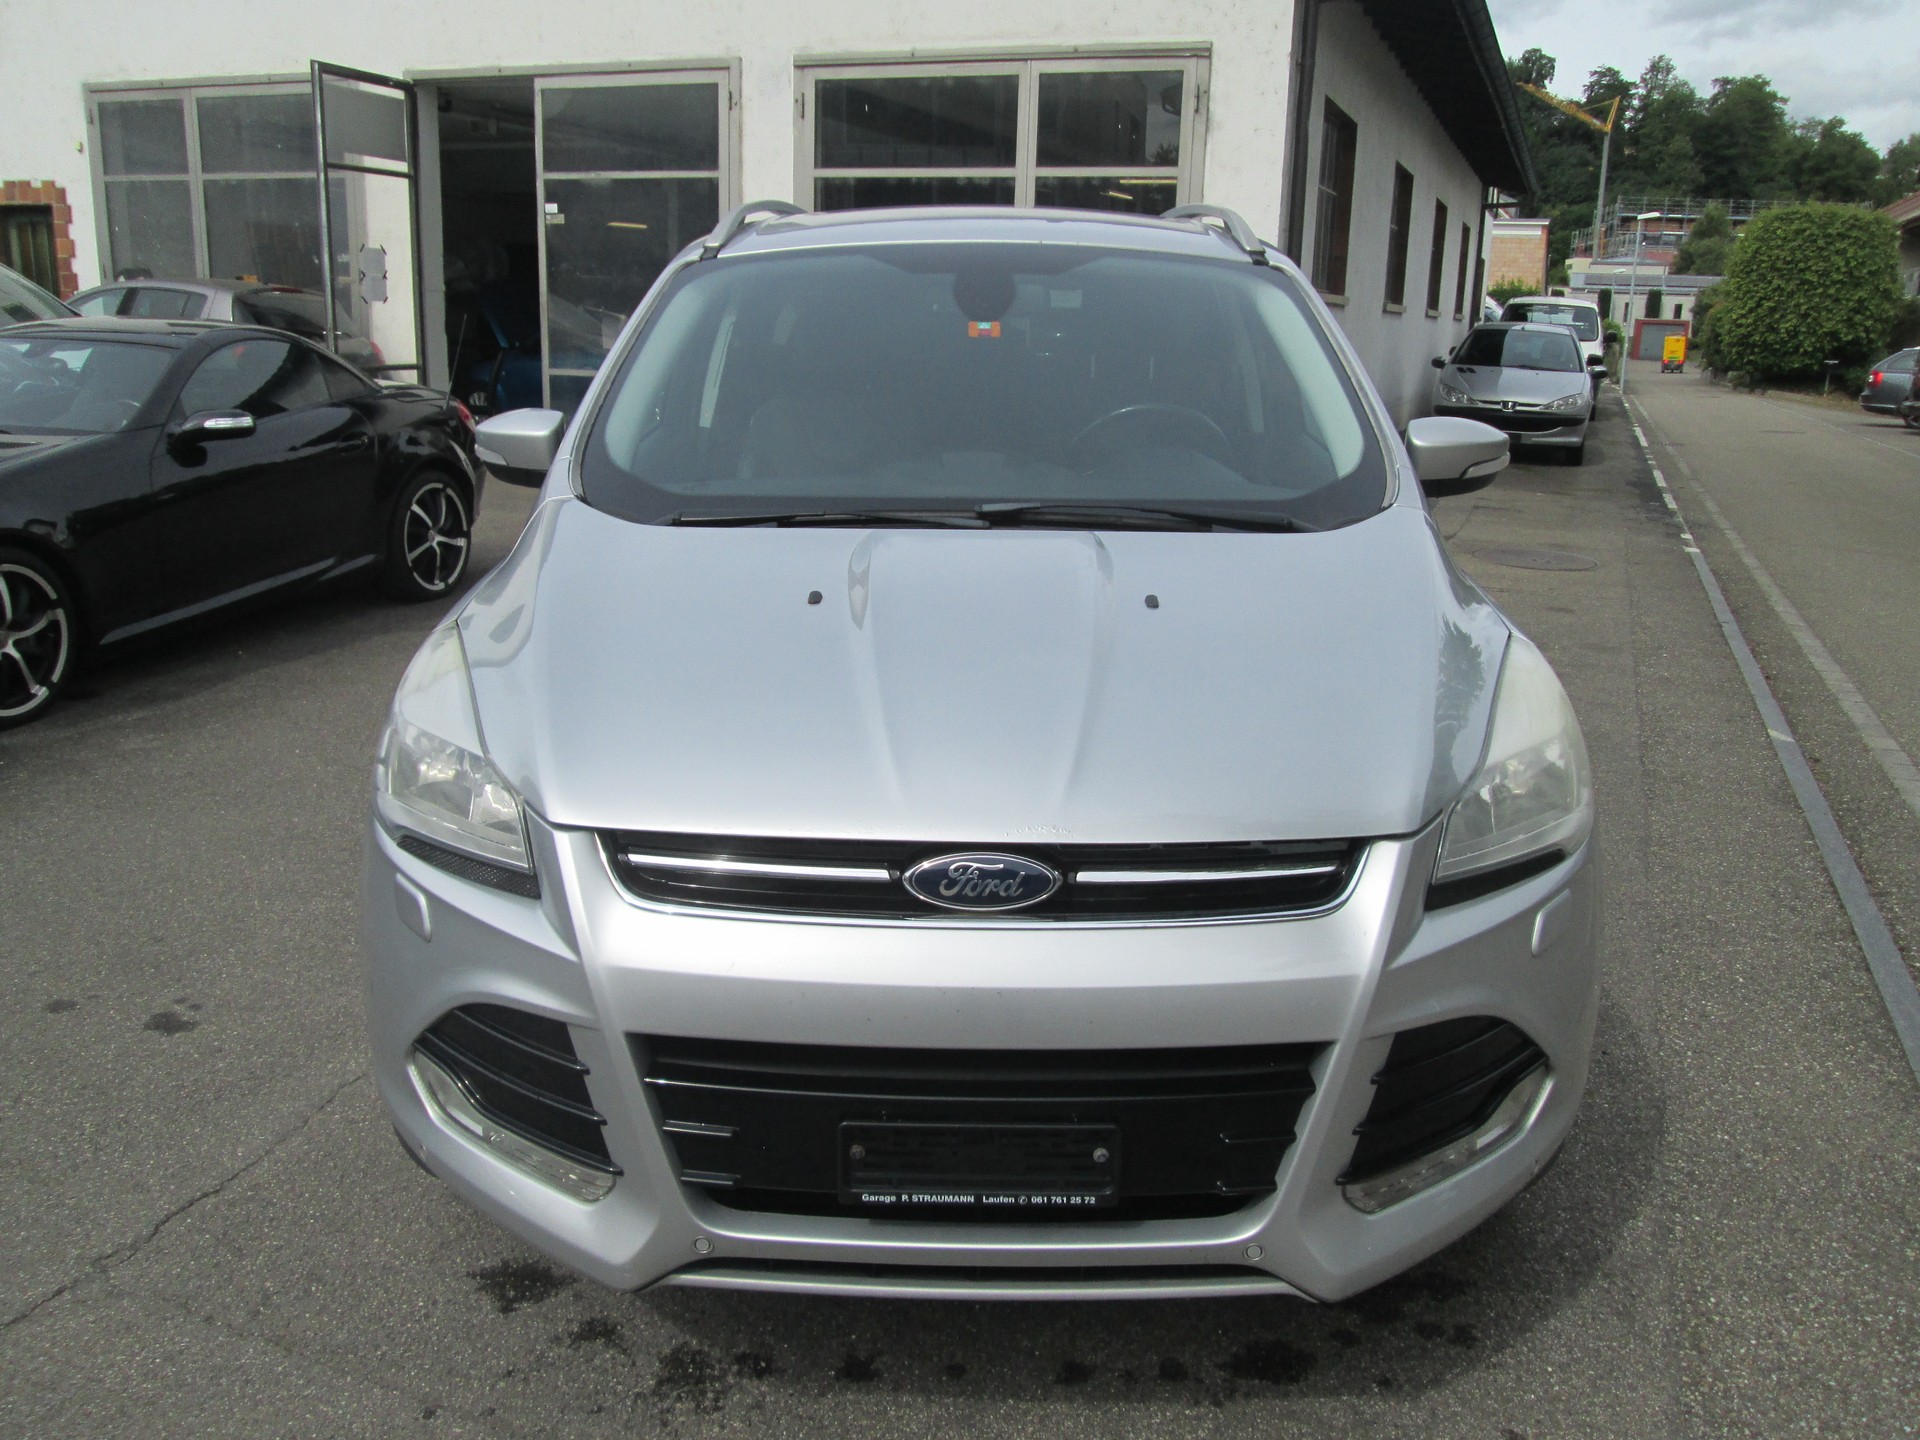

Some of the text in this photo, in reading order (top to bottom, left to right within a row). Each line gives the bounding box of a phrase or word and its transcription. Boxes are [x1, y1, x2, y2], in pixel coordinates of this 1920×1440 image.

[939, 861, 1026, 897] Ford
[861, 1193, 897, 1204] Garage
[911, 1194, 975, 1203] STRAUMANN
[982, 1195, 1015, 1204] Laufen
[1031, 1195, 1048, 1204] 061
[1050, 1195, 1067, 1204] 761
[1070, 1195, 1082, 1204] 25
[1083, 1195, 1096, 1204] 72
